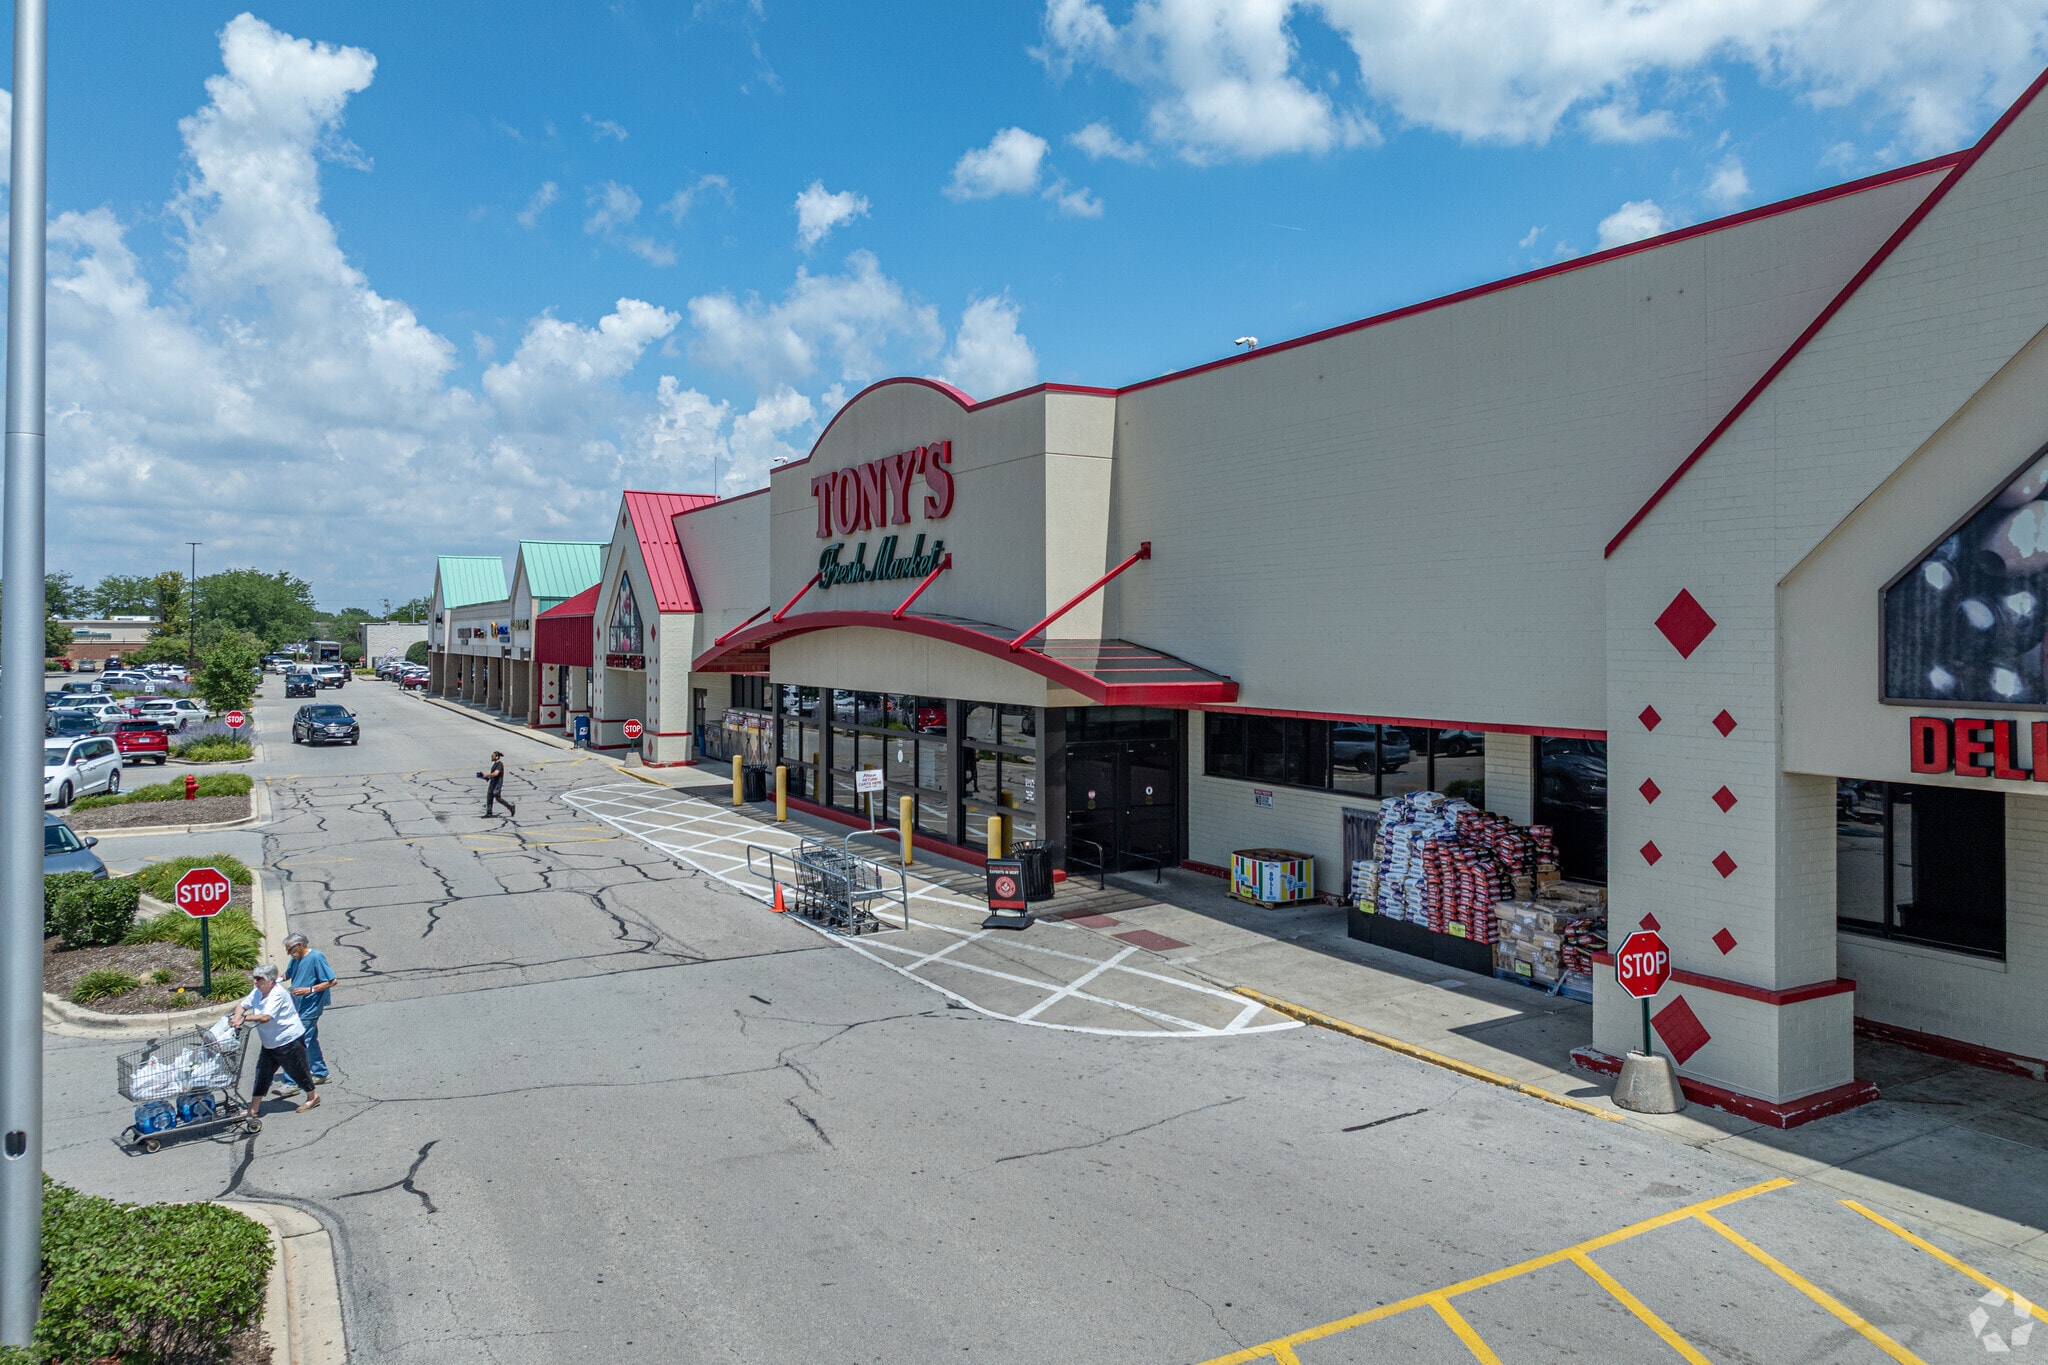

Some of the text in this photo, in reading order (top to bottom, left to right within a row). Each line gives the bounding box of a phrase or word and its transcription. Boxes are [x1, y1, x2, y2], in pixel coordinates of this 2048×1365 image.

[811, 440, 955, 538] TONY'S
[818, 534, 945, 590] Fresh Market
[227, 715, 245, 724] STOP
[625, 725, 642, 733] STOP
[179, 882, 227, 904] STOP
[1621, 950, 1668, 979] STOP
